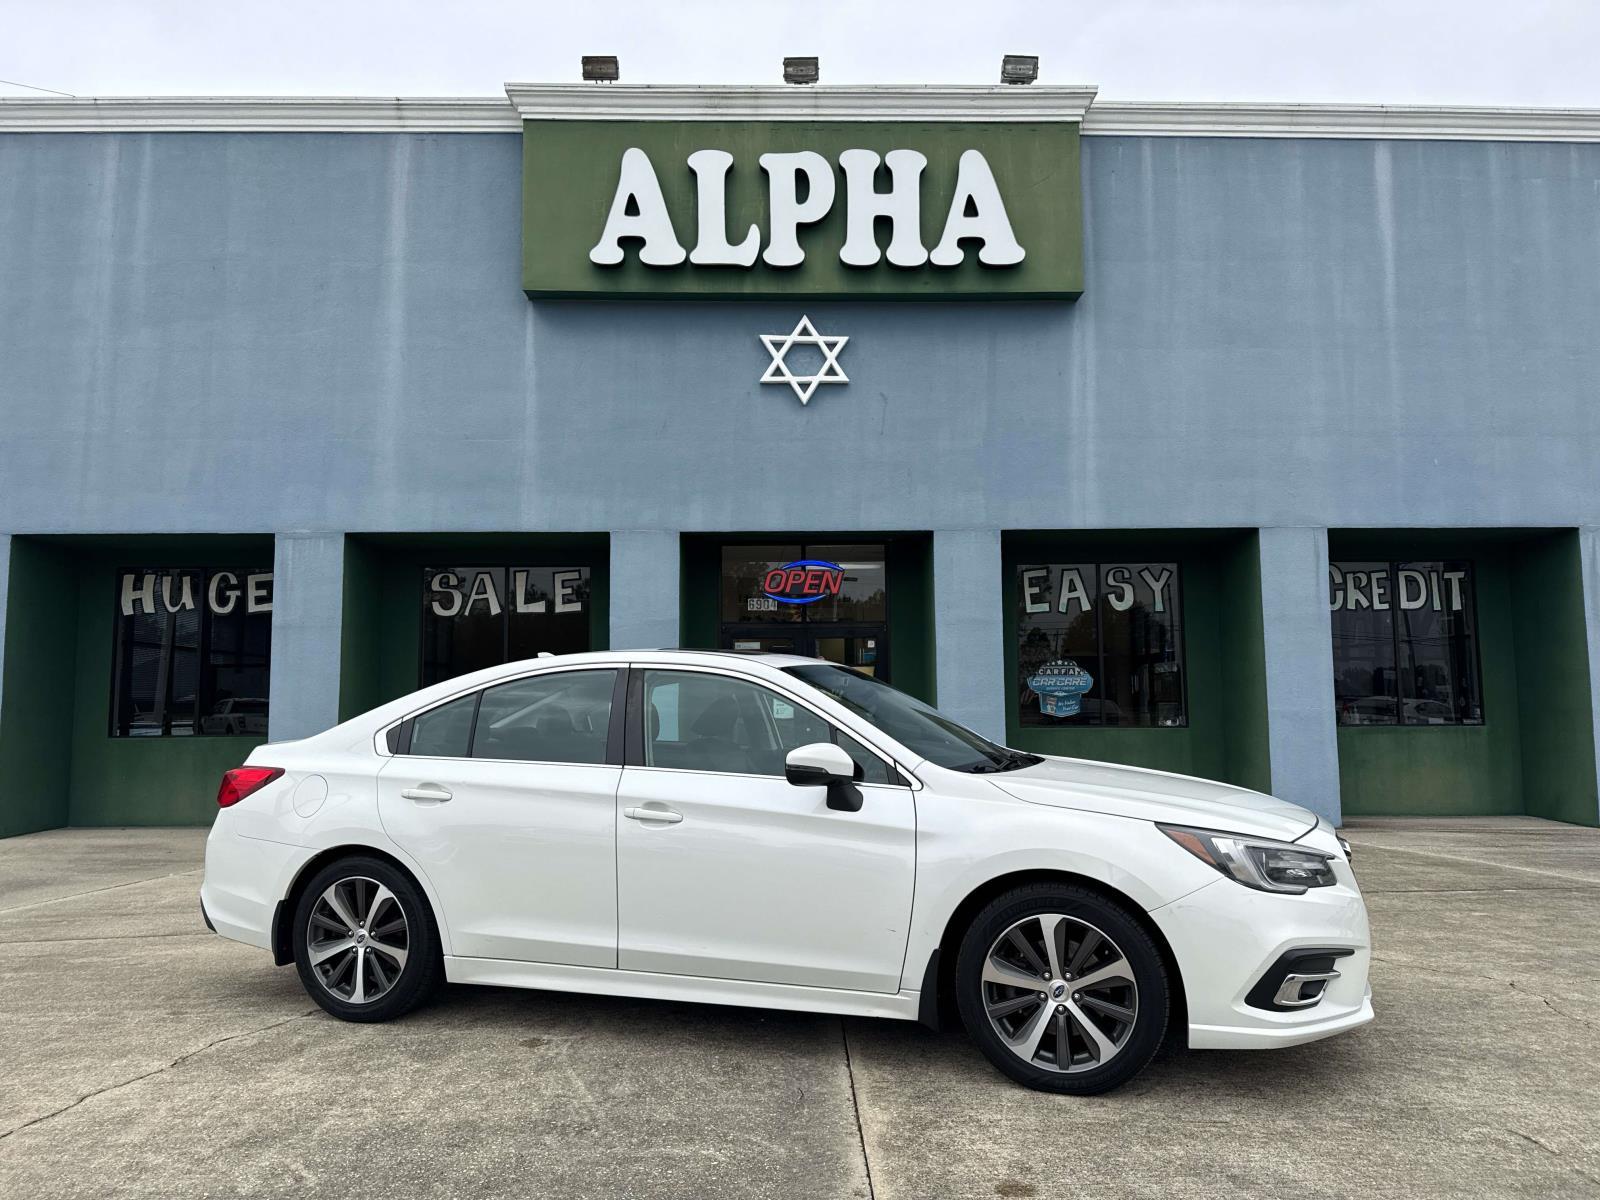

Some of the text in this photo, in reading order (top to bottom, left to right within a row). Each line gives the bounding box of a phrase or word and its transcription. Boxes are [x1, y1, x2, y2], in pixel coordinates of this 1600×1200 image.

[589, 147, 1026, 268] ALPHA
[120, 570, 583, 617] HUGE SALE
[764, 570, 844, 594] OPEN
[1022, 567, 1174, 613] EASY
